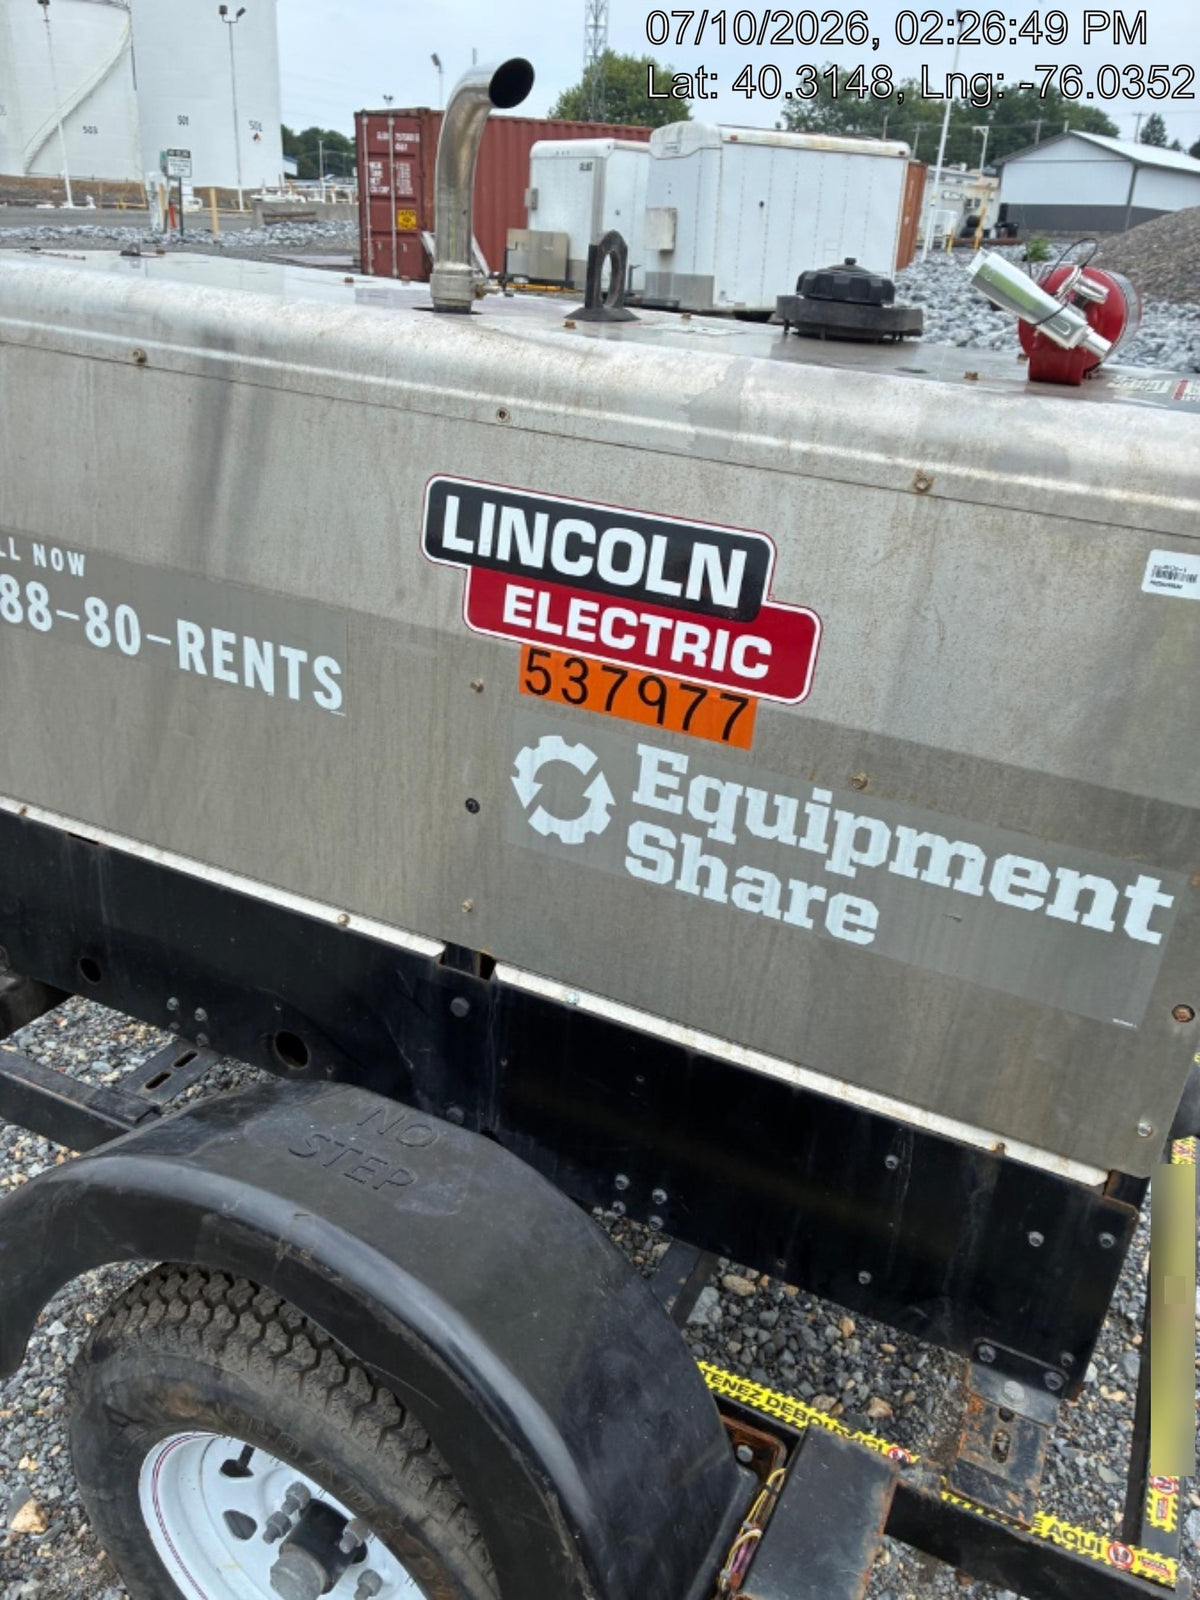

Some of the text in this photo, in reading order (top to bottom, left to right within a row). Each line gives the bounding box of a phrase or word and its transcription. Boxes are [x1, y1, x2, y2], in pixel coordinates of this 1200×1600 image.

[32, 541, 86, 577] NOW
[441, 495, 747, 609] LINCOLN
[502, 583, 772, 680] ELECTRIC
[524, 648, 750, 741] 537977
[624, 819, 880, 945] Share
[631, 743, 1174, 945] Equipment
[288, 1133, 418, 1190] STEP
[357, 1108, 440, 1148] NO
